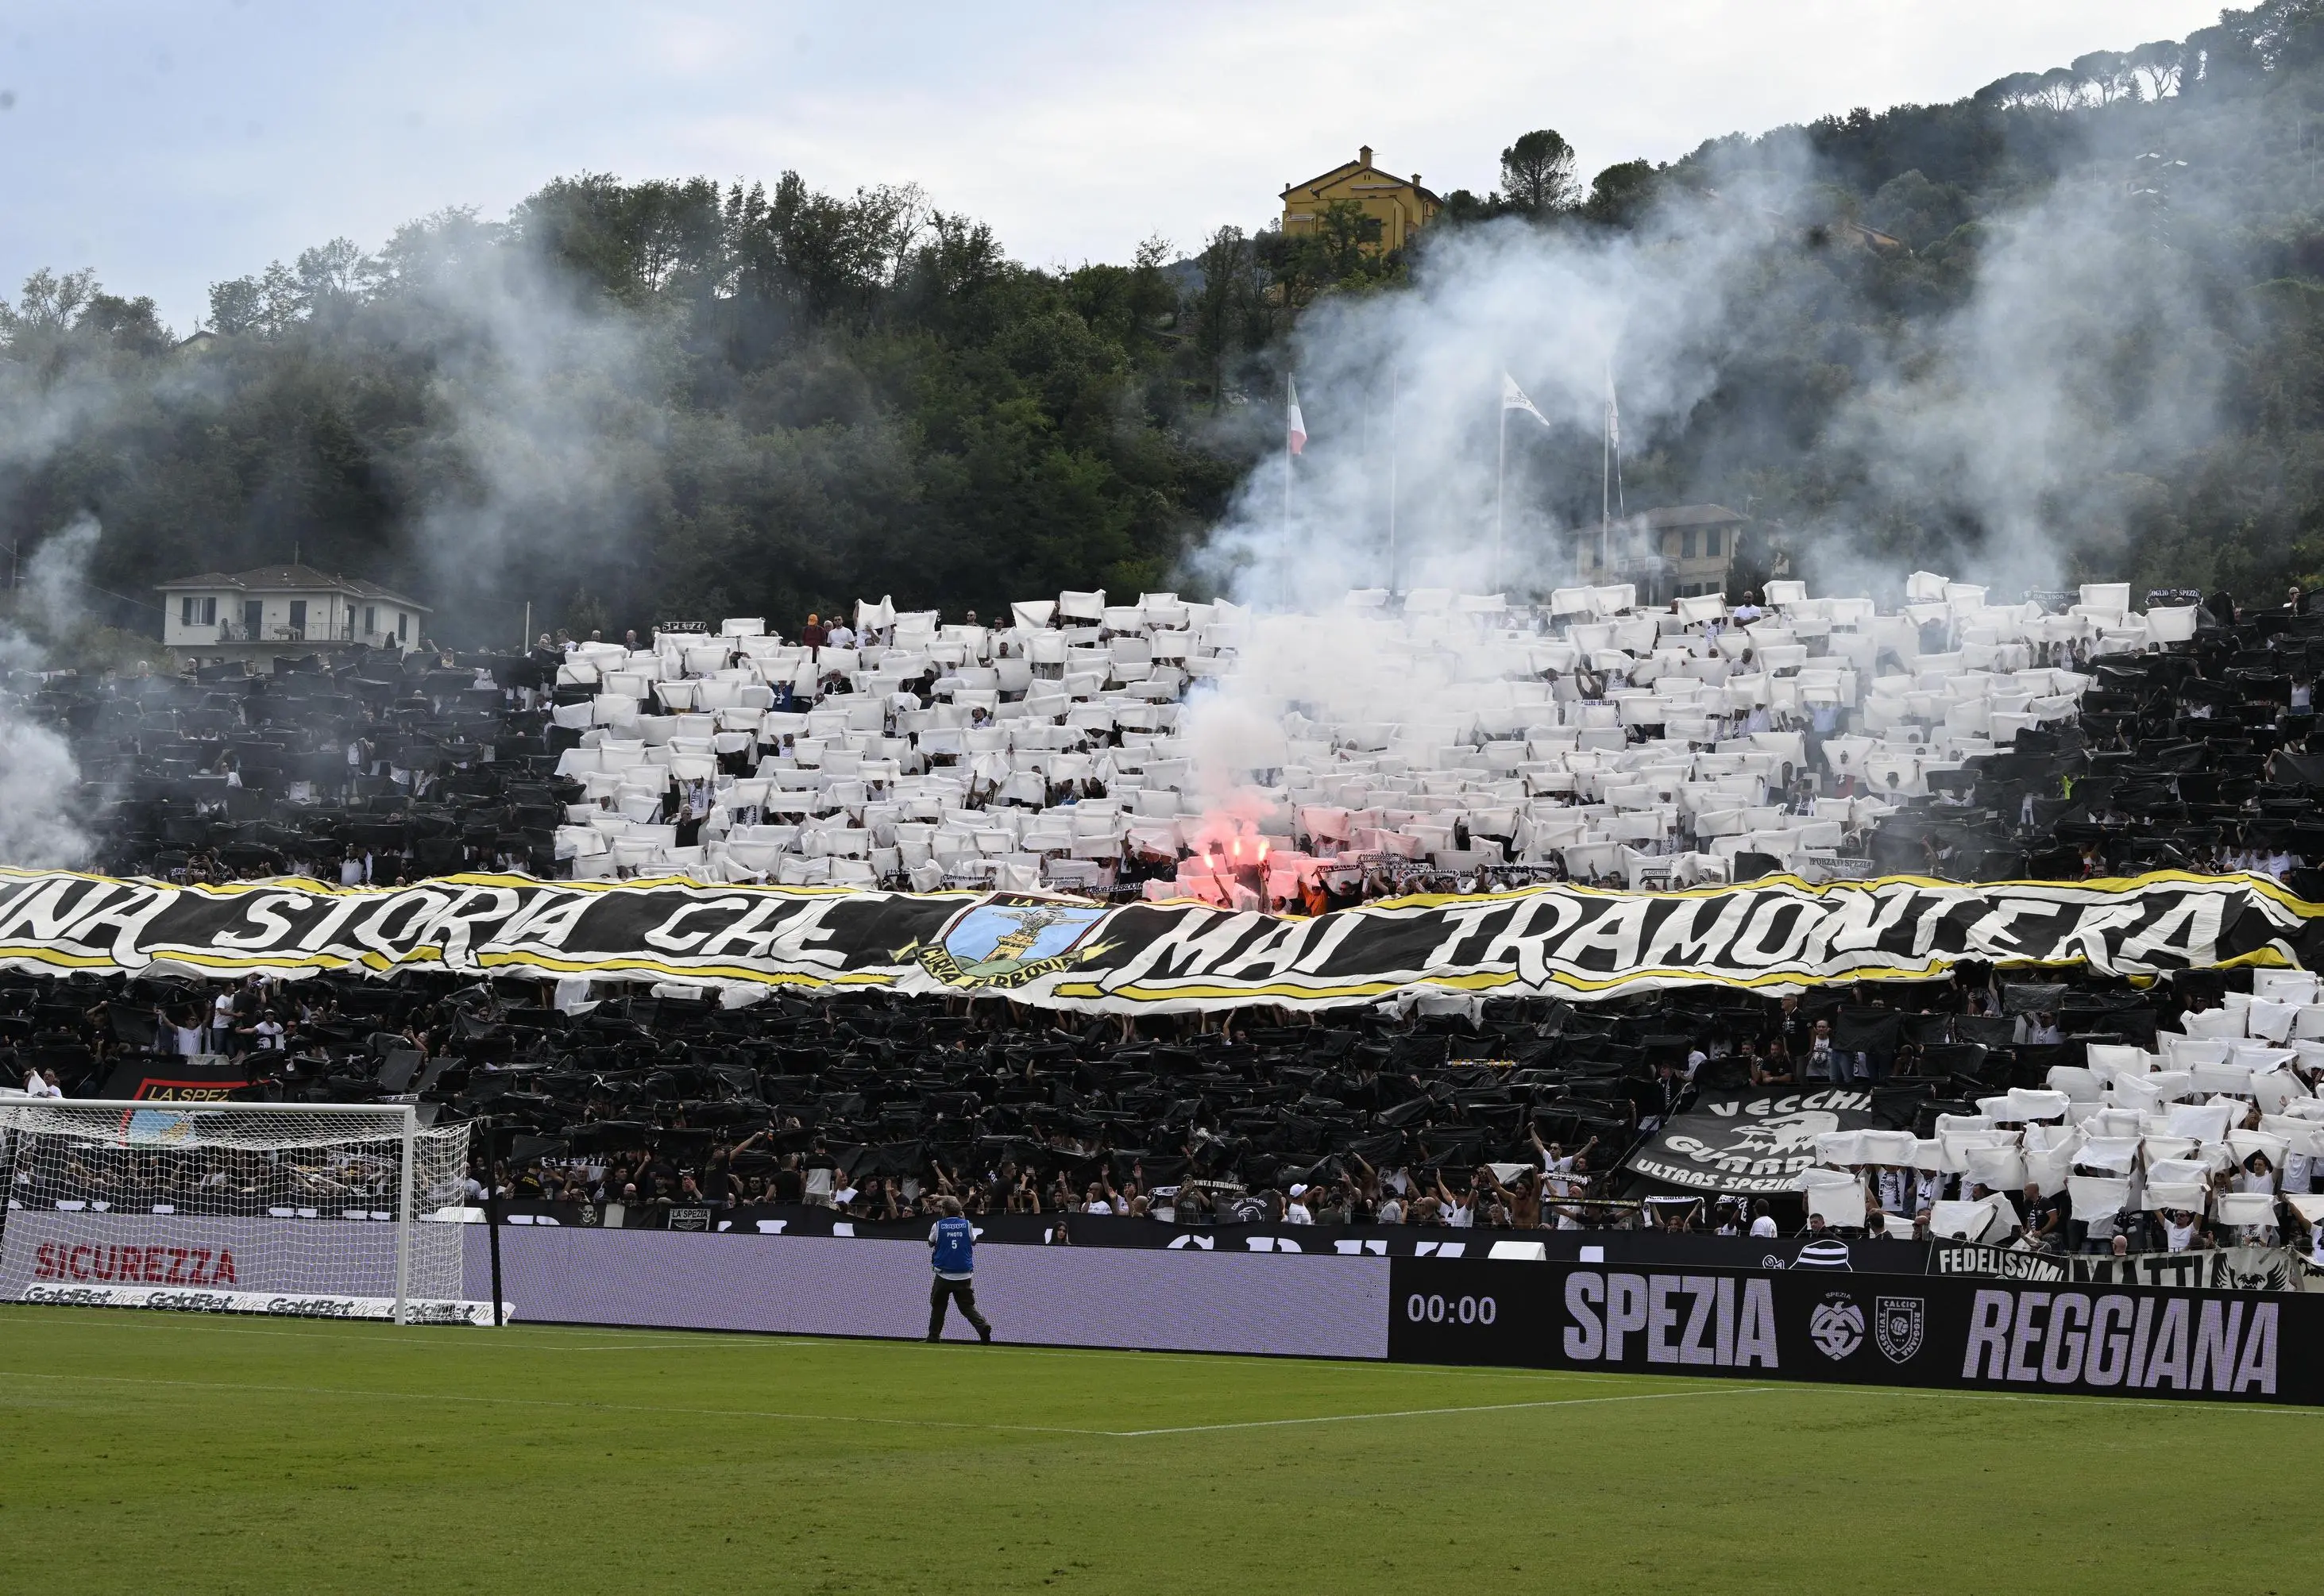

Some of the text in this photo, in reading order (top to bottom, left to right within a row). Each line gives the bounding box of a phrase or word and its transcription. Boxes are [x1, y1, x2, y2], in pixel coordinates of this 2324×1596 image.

[1812, 858, 1871, 869] FORZA SPEZIA
[1007, 897, 1034, 907] LA
[211, 887, 607, 969] STORIA
[645, 894, 891, 970] CHE
[1099, 908, 1368, 994] MAI
[919, 946, 1074, 990] CURVA FERROVIA
[148, 1086, 230, 1102] LA SPEZ
[1666, 1135, 1816, 1175] GUARD
[1636, 1158, 1793, 1190] ULTRAS SPEZIA
[672, 1209, 708, 1218] LA SPEZIA
[952, 1239, 958, 1249] 5
[36, 1243, 236, 1284] SICUREZZA
[1407, 1294, 1496, 1325] 00:00
[1825, 1291, 1851, 1300] SPEZIA
[1884, 1300, 1917, 1309] CALCIO
[1563, 1270, 1779, 1368] SPEZIA
[1900, 1312, 1921, 1356] REGGIANA
[1961, 1289, 2279, 1394] REGGIANA
